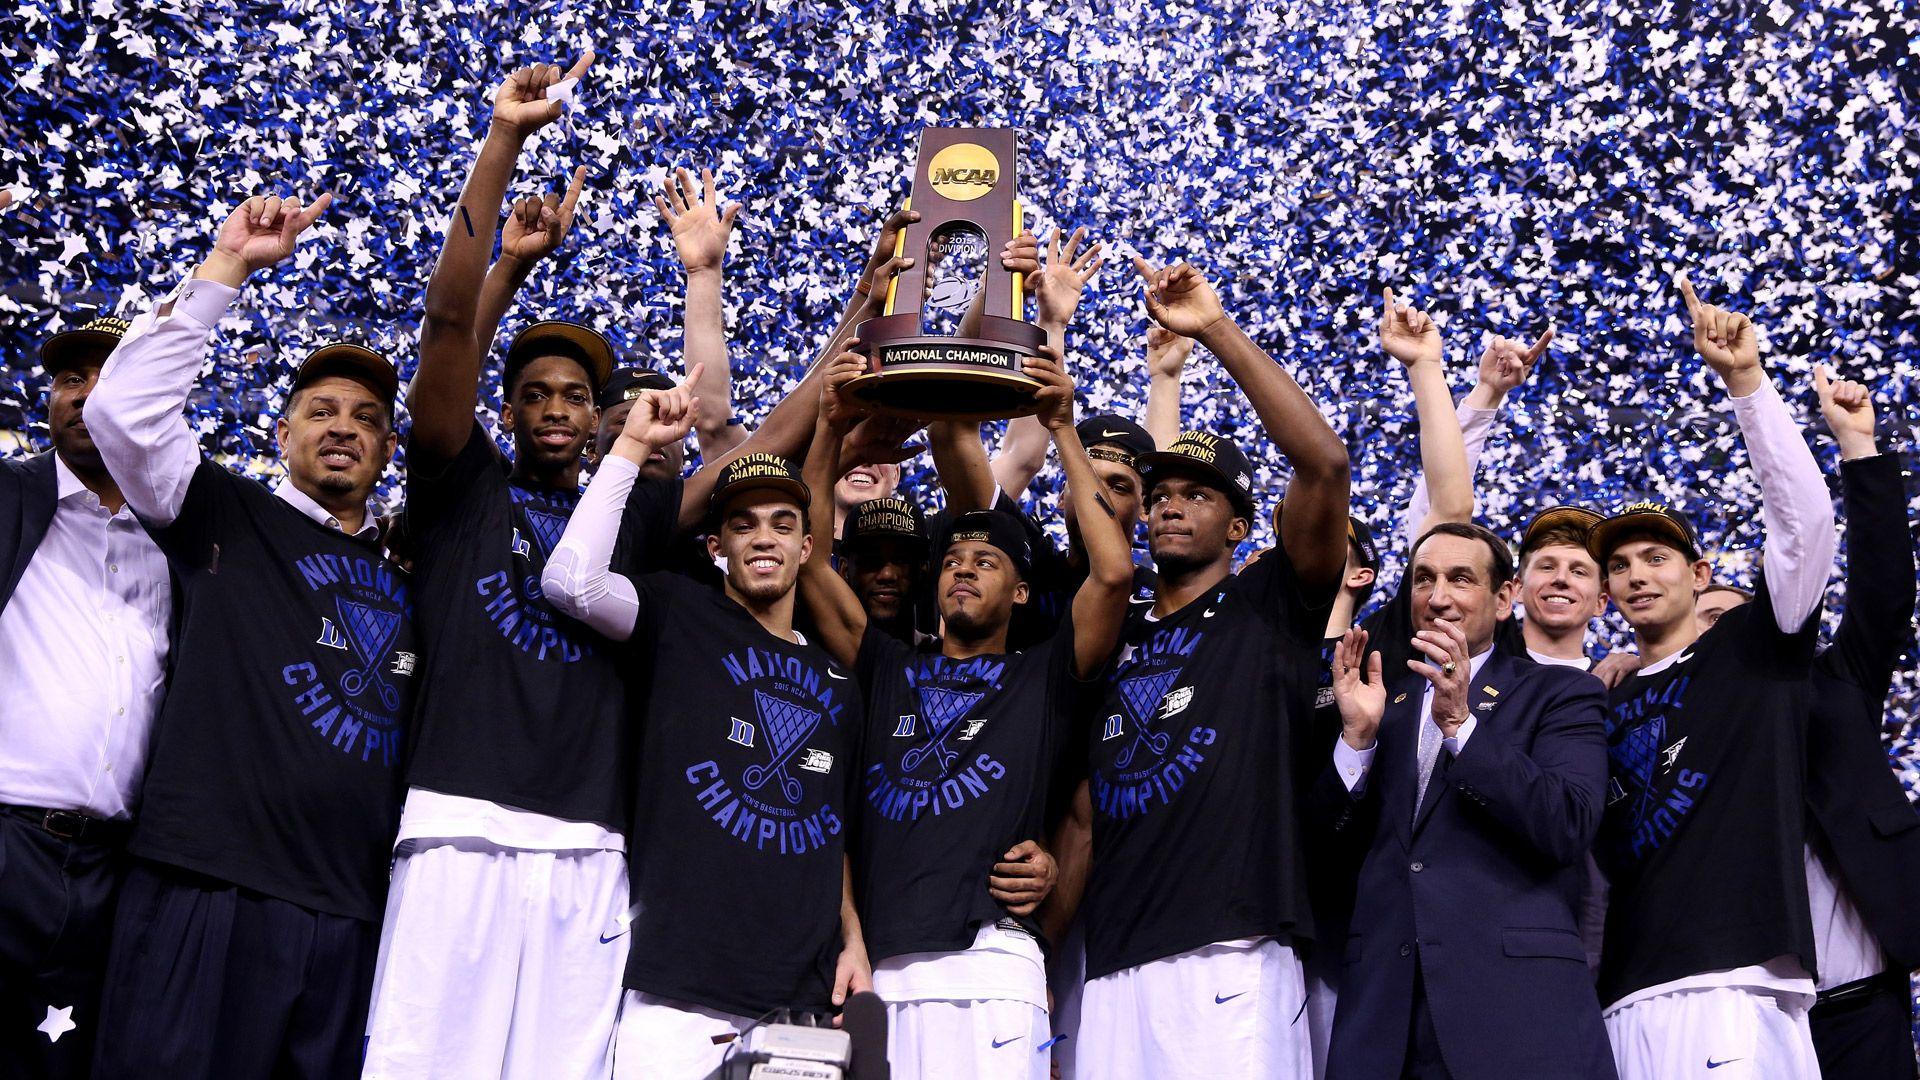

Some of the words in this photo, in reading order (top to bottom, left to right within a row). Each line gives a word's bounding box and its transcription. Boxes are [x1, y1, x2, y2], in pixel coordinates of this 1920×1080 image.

[932, 168, 996, 187] NCAA
[885, 349, 943, 363] NATIONAL
[945, 350, 1008, 367] CHAMPION
[729, 452, 788, 473] NATIONAL
[860, 498, 914, 518] NATIONAL
[857, 512, 915, 531] CHAMPIONS
[721, 647, 844, 727] NATIONAL
[727, 716, 755, 748] D
[892, 714, 916, 737] D
[1102, 713, 1124, 741] D
[686, 760, 843, 855] CHAMPIONS
